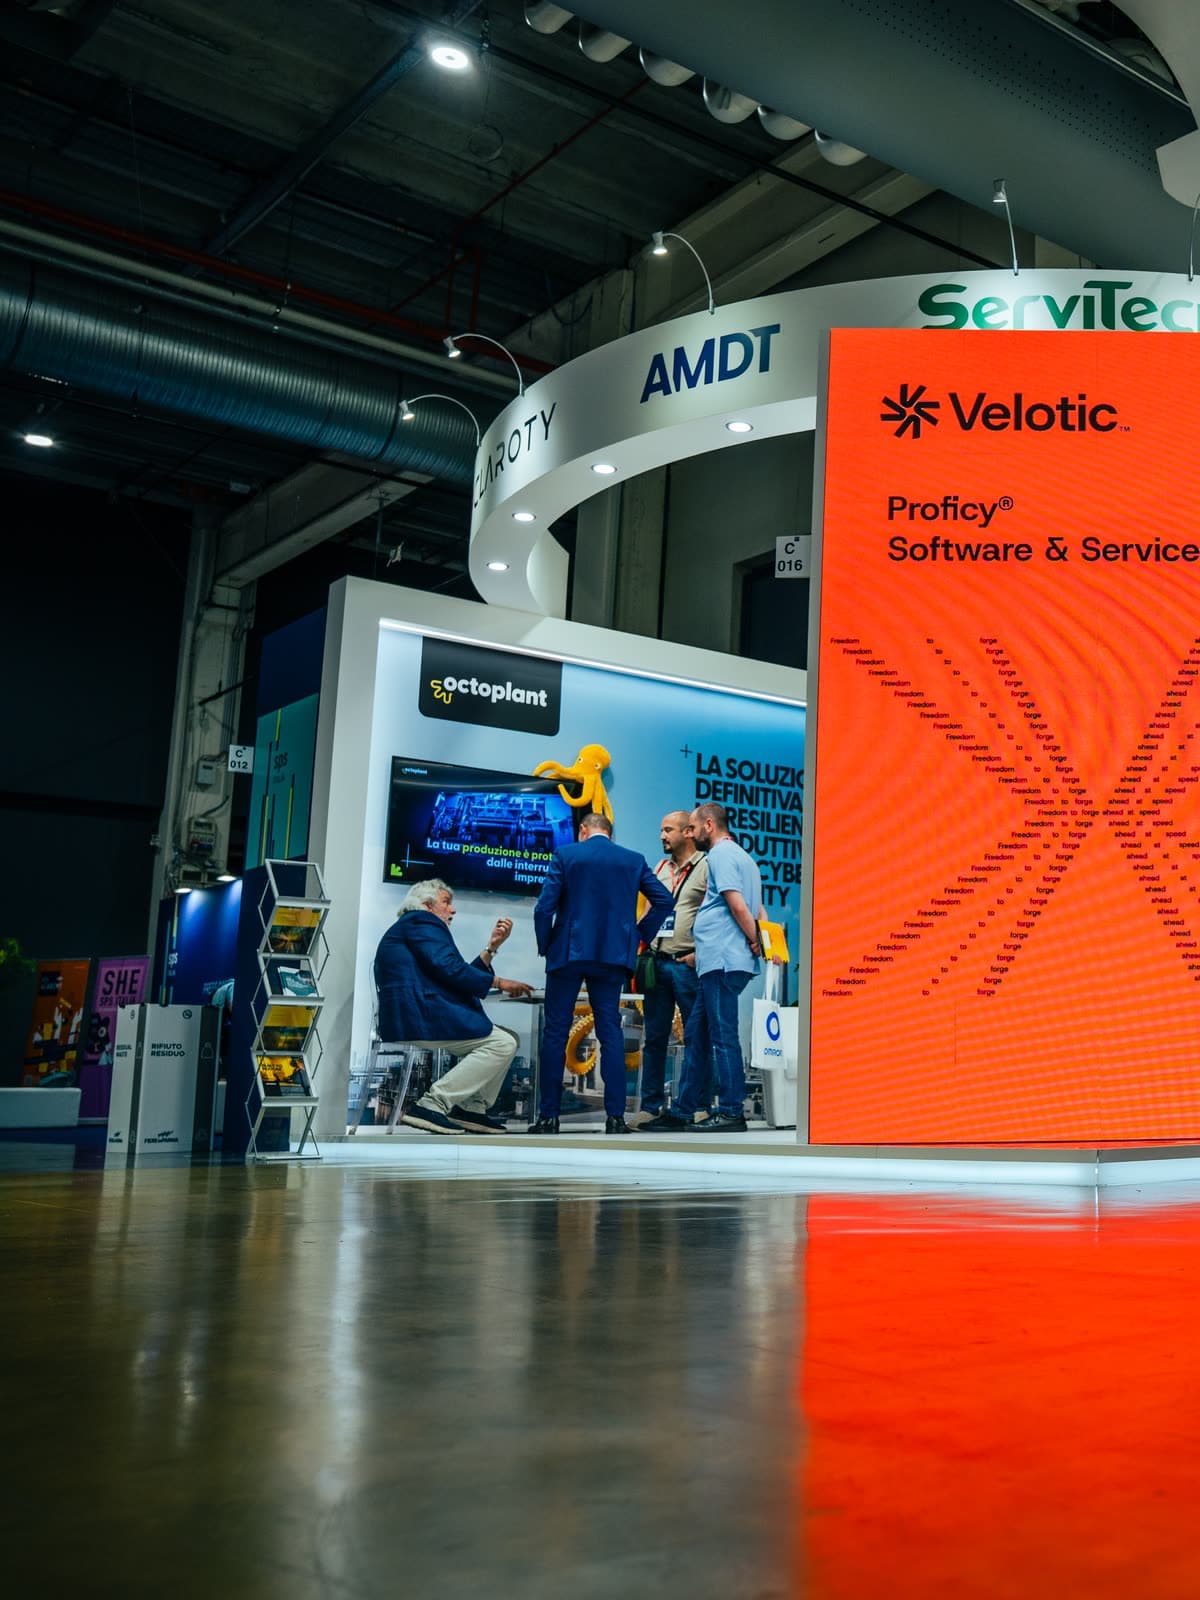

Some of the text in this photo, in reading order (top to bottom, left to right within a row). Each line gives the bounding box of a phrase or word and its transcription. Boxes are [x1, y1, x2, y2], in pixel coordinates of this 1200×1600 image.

[640, 324, 780, 404] AMDT
[785, 543, 795, 555] C
[887, 537, 1033, 563] Software
[1045, 537, 1068, 562] &
[778, 560, 803, 572] 016
[444, 675, 548, 708] octoplant
[236, 750, 244, 758] C
[1043, 744, 1061, 752] forge
[230, 760, 248, 770] 012
[696, 752, 722, 777] LA
[1055, 766, 1073, 774] forge
[695, 777, 804, 812] DEFINITIVA
[1068, 831, 1087, 839] forge
[426, 838, 440, 849] La
[442, 840, 461, 851] tua
[462, 844, 522, 858] produzione
[523, 847, 530, 859] è
[486, 857, 513, 869] dalle
[1030, 898, 1048, 906] forge
[990, 966, 1008, 974] forge
[102, 968, 141, 995] SHE
[977, 989, 996, 997] forge
